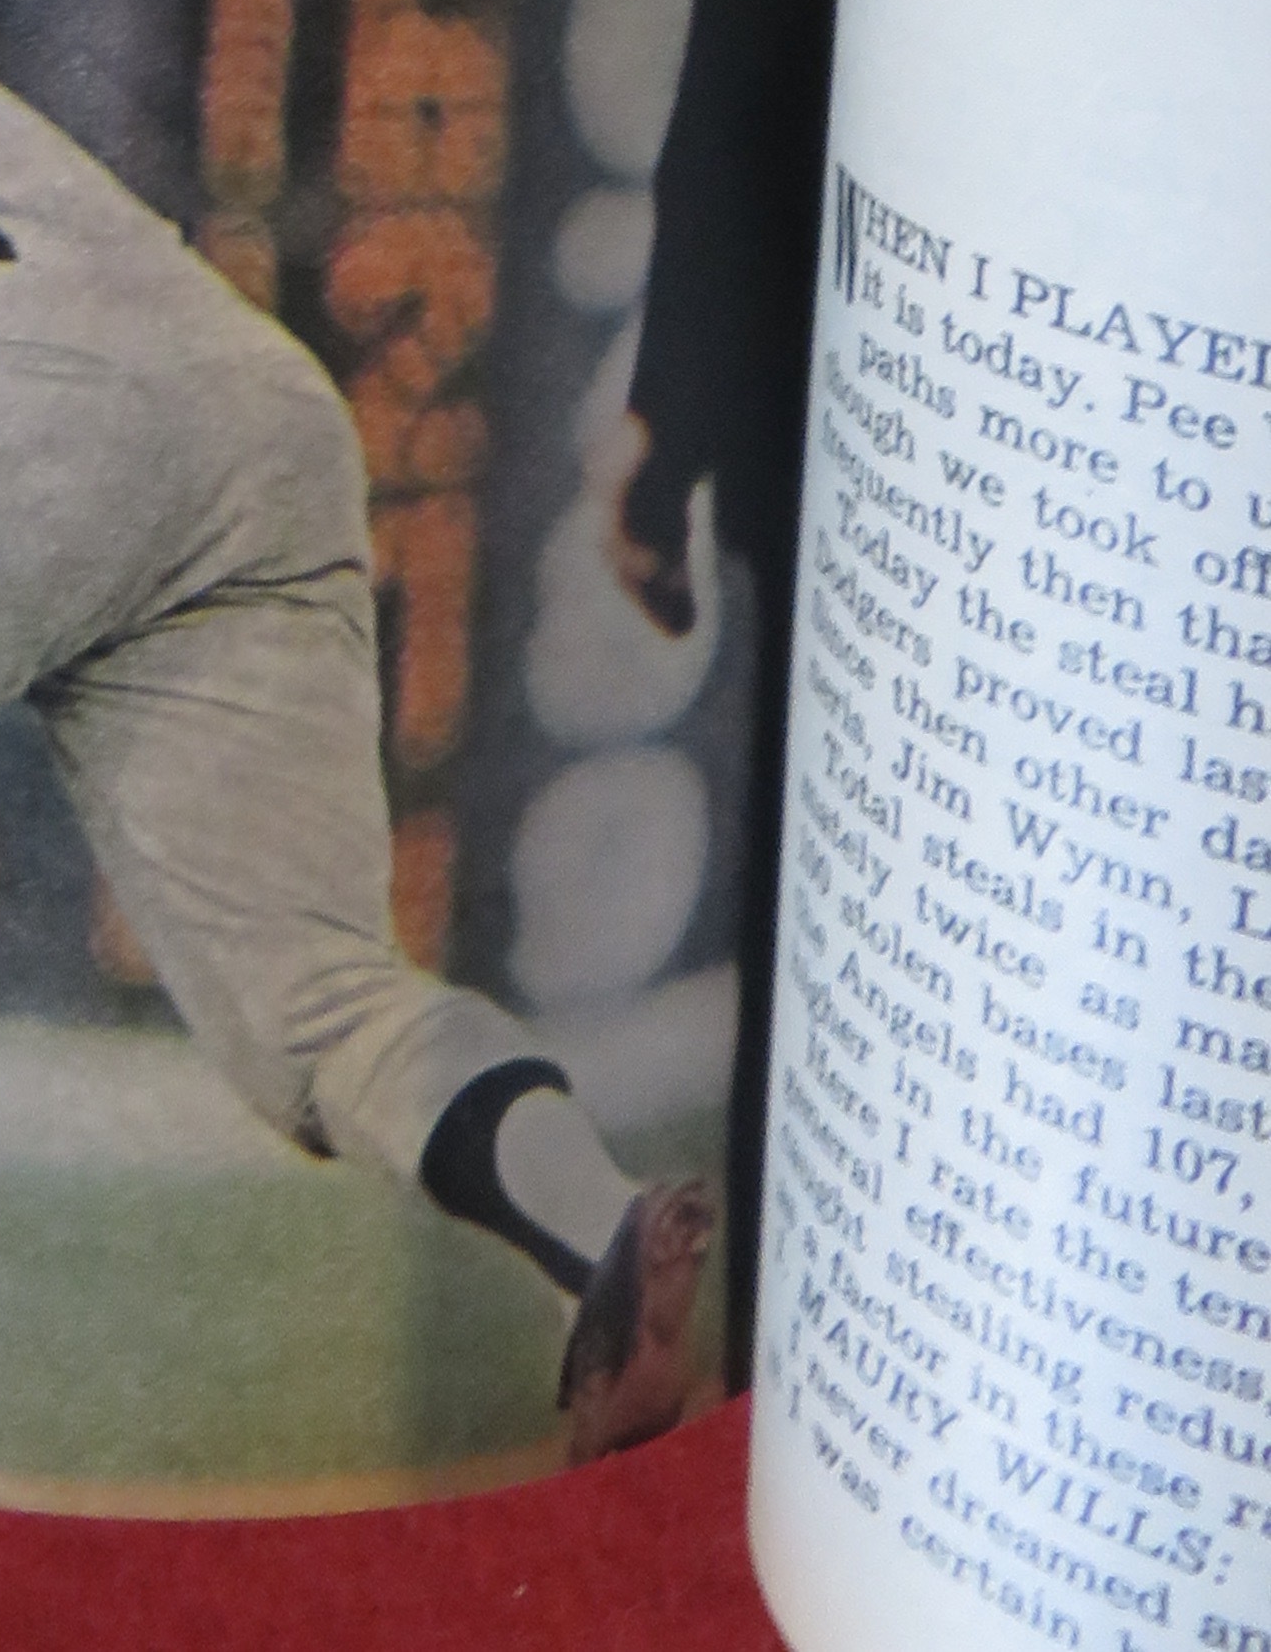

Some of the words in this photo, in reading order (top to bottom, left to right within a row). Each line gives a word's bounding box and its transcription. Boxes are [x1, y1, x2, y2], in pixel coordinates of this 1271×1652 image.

[861, 260, 885, 310] it
[894, 283, 926, 338] is
[939, 311, 1097, 414] today.
[1121, 373, 1239, 450] Pee
[968, 251, 991, 301] I
[824, 349, 917, 462] ough
[938, 449, 1008, 508] we
[1033, 485, 1160, 567] took
[857, 330, 957, 421] paths
[978, 402, 1121, 485] more
[1151, 456, 1213, 512] to
[957, 583, 1038, 655] the
[1057, 638, 1200, 717] steal
[1019, 546, 1147, 633] then
[891, 673, 989, 765] then
[1013, 754, 1171, 838] other
[957, 655, 1145, 766] proved
[891, 737, 973, 822] Jim
[1003, 797, 1193, 927] Wynn,
[922, 832, 1065, 933] steals
[1093, 906, 1149, 969] in
[840, 894, 955, 1004] stolen
[980, 979, 1130, 1093] bases
[915, 883, 1048, 990] twice
[1078, 980, 1142, 1032] as
[836, 947, 979, 1083] Angels
[1004, 1058, 1108, 1148] had
[1144, 1124, 1256, 1214] 107,
[893, 1055, 935, 1119] in
[961, 1105, 1045, 1183] the
[1073, 1162, 1271, 1276] future
[894, 1118, 914, 1164] I
[929, 1154, 1034, 1242] rate
[1054, 1220, 1149, 1296] the
[884, 1247, 1085, 1407] stealing
[1114, 1385, 1271, 1469] redu
[968, 1360, 1019, 1427] in
[1044, 1407, 1204, 1511] these
[899, 1513, 1083, 1650] certain
[928, 1467, 1173, 1629] dreamed
[992, 1435, 1236, 1587] WILLS:
